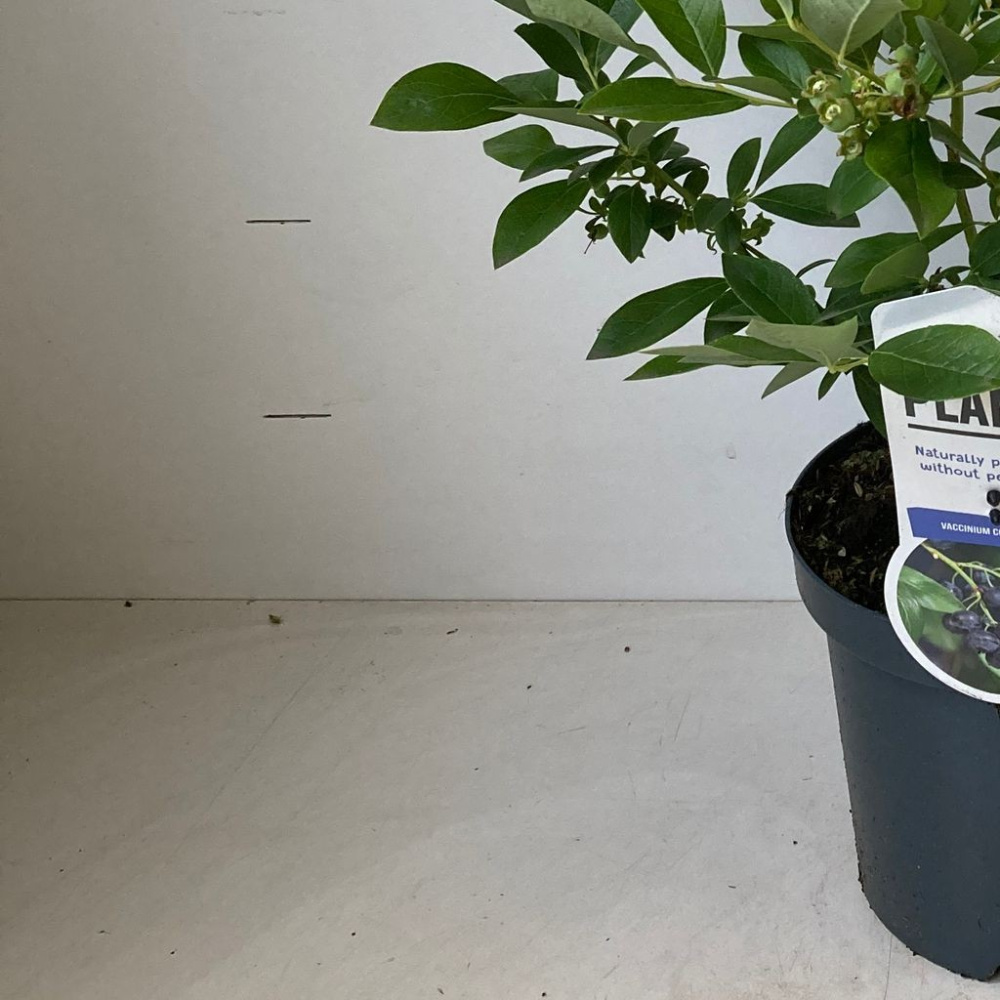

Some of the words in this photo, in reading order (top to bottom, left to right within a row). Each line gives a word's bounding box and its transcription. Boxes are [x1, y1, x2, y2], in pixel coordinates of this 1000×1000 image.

[915, 445, 984, 467] Naturally
[920, 462, 981, 480] without
[940, 521, 991, 535] VACCINIUM
